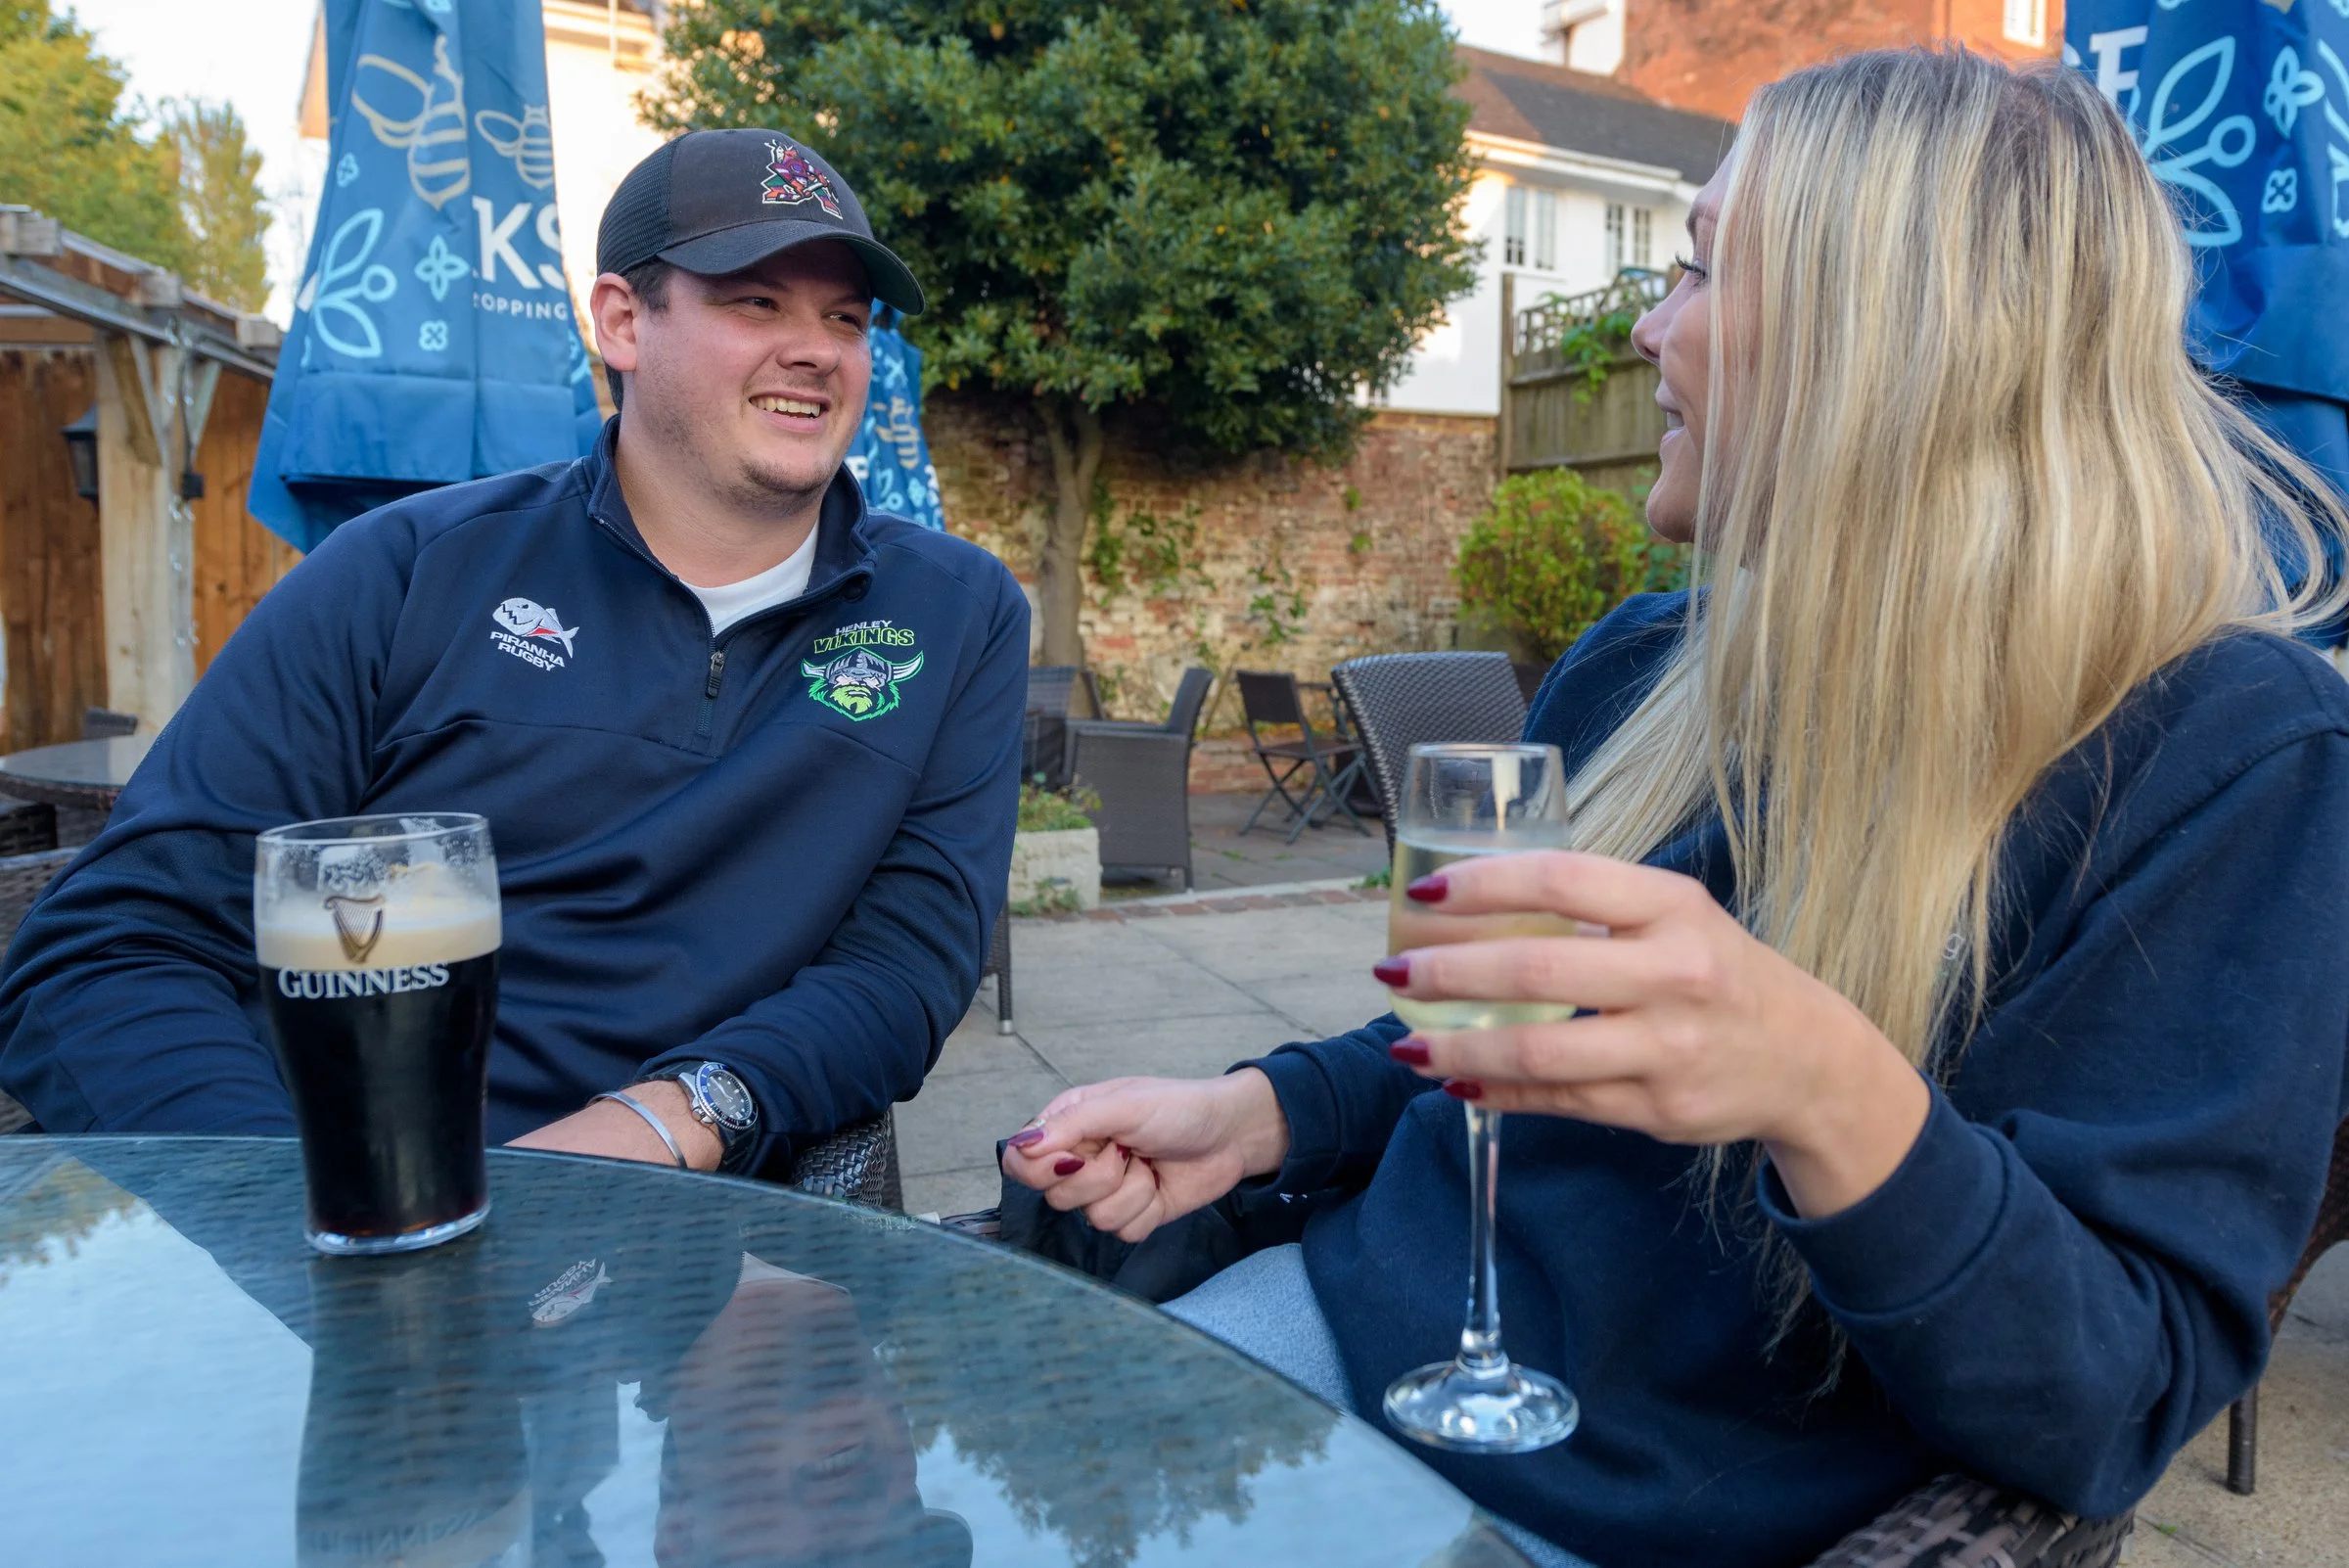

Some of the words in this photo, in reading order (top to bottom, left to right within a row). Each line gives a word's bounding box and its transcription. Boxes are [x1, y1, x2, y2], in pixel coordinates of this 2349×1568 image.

[472, 195, 567, 292] KS
[474, 291, 569, 321] OPPING
[813, 626, 915, 654] VIKINGS
[835, 619, 893, 635] HENLEY
[489, 630, 566, 668] PIRANHA
[497, 641, 556, 672] RUGBY
[278, 960, 450, 999] GUINNESS
